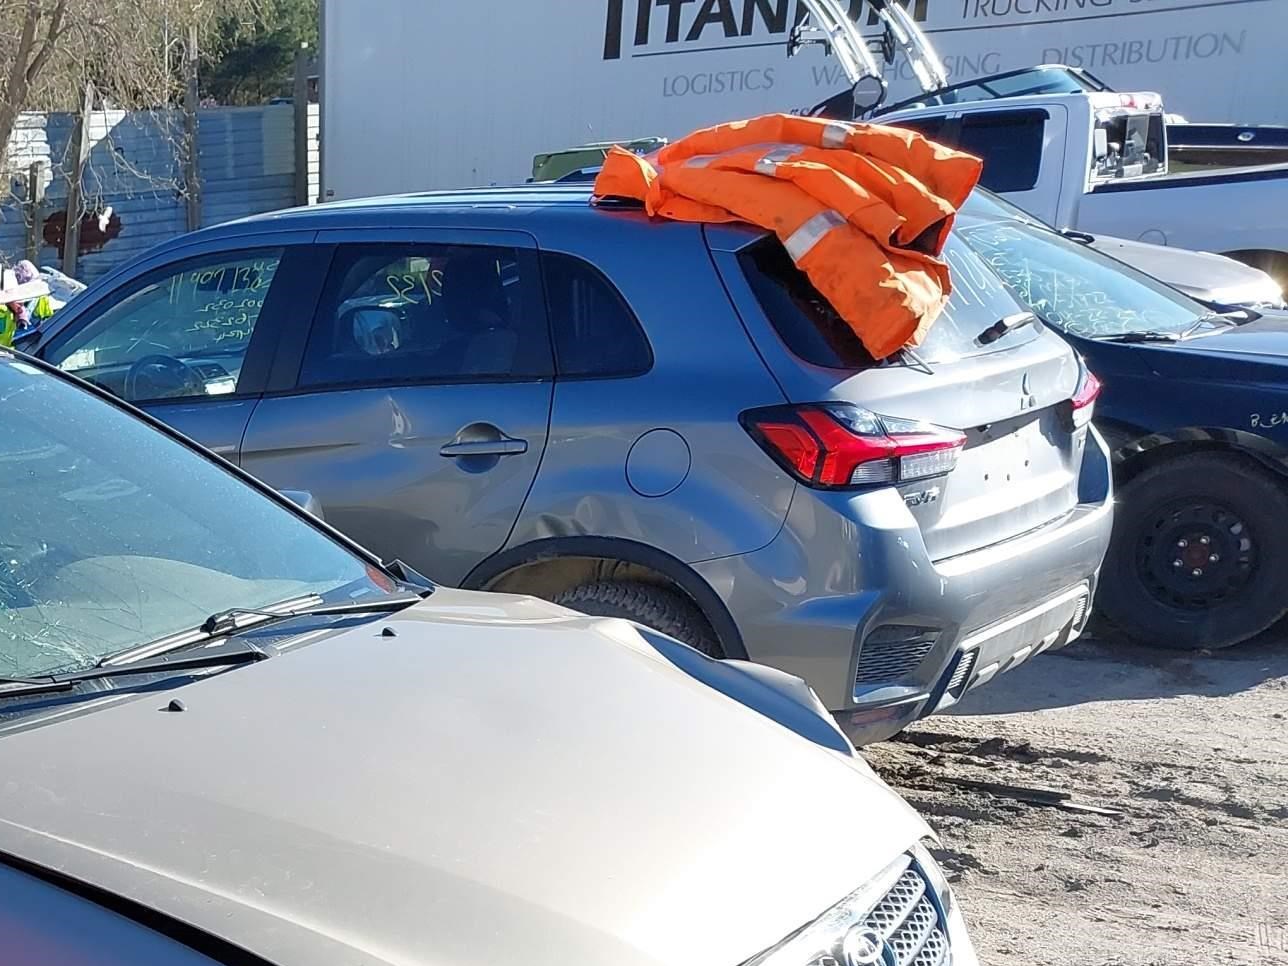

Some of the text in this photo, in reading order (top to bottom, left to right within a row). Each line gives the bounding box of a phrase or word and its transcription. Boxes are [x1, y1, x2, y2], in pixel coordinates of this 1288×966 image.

[962, 0, 1112, 19] TRUCK
[663, 29, 1247, 97] LOGISTICS WAHOSING DISTRIBUTION
